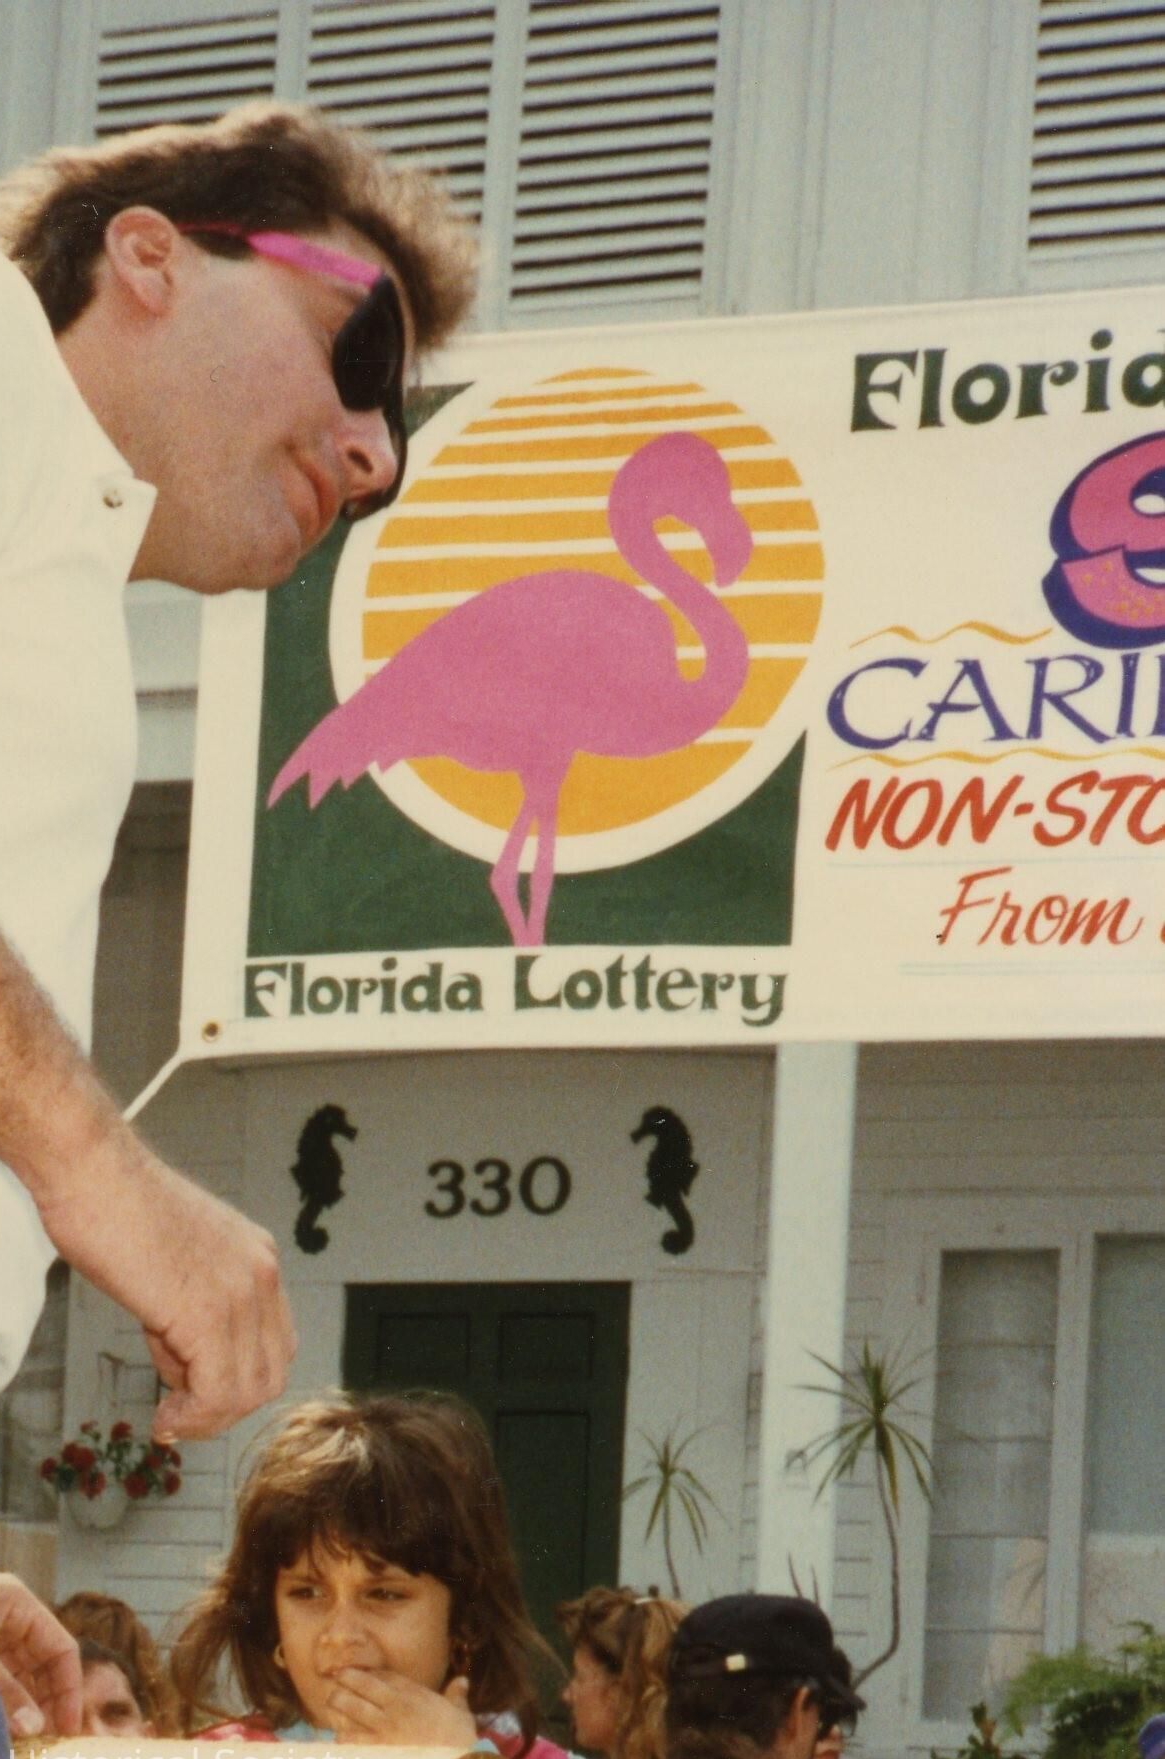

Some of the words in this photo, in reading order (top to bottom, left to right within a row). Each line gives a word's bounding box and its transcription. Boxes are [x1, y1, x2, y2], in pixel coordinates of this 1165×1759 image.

[826, 652, 1165, 750] CARI
[936, 866, 1143, 946] From
[244, 956, 484, 1018] Florida
[514, 953, 788, 1027] Lottery
[424, 1155, 572, 1218] 330
